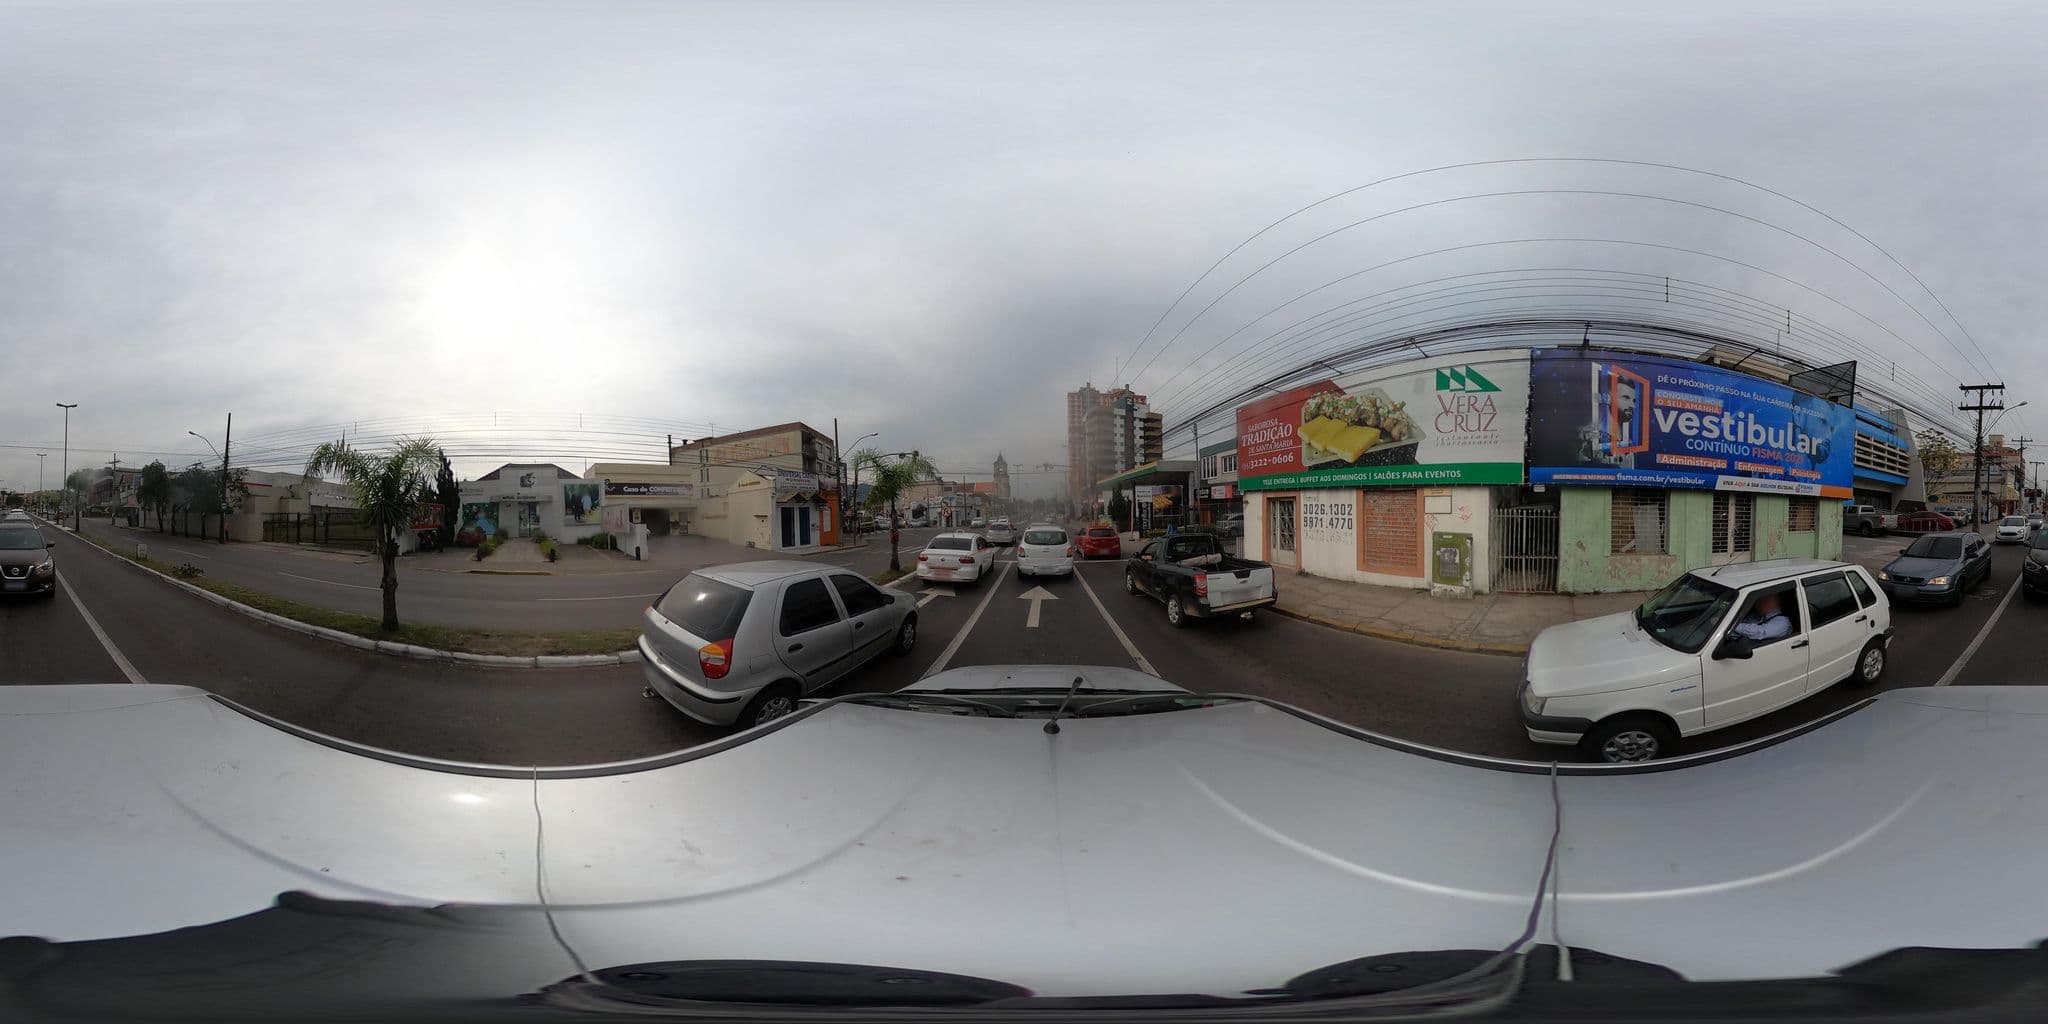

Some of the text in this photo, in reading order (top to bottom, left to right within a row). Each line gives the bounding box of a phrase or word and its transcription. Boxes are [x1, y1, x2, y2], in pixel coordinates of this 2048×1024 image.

[1678, 379, 1715, 391] PRÓXIMO
[1715, 384, 1739, 396] PASSO
[1740, 389, 1751, 398] NA
[1753, 393, 1766, 403] SUA
[1437, 393, 1497, 416] VERA
[1247, 418, 1279, 432] SABOROSA
[1435, 411, 1497, 434] CRUZ
[1241, 422, 1293, 447] TRADIÇÃO
[1654, 408, 1823, 456] vestibular
[1256, 443, 1273, 452] SANTA
[1273, 439, 1293, 449] MARIA
[1685, 438, 1750, 456] CONTÍNUO
[1752, 447, 1783, 460] FISMA
[1660, 455, 1727, 470] Administração
[1273, 477, 1296, 485] ENTREGA
[1332, 473, 1368, 481] DOMINGOS
[1373, 470, 1461, 480] SALÕES PARA EVENTOS
[1616, 473, 1705, 485] fisma.com.br/vestibular
[1303, 504, 1353, 516] 3026.1302
